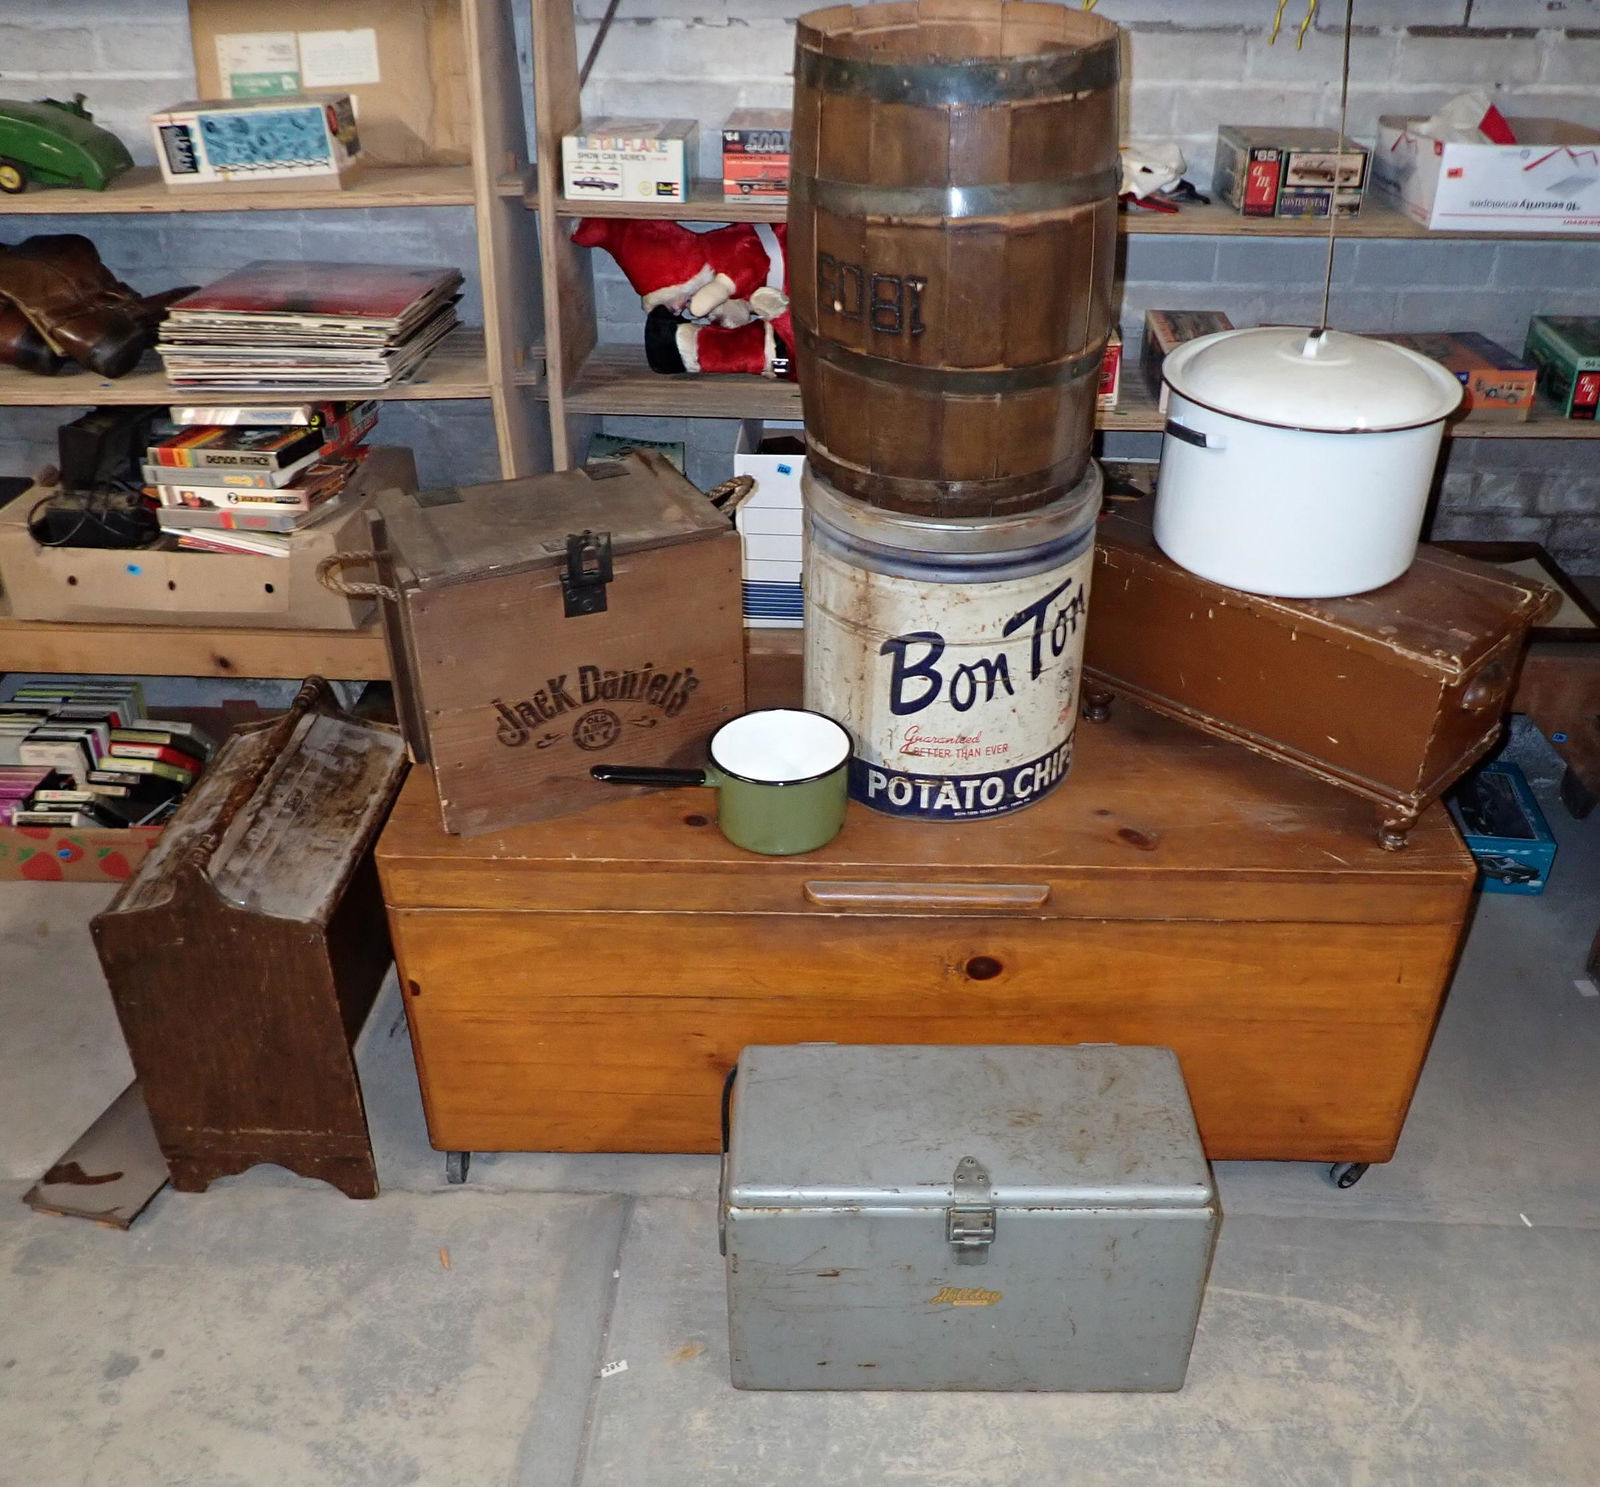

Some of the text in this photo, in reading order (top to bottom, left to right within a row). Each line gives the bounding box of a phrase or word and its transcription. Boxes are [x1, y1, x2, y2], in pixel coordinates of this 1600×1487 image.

[206, 455, 237, 465] DEMON
[879, 577, 1085, 716] Bon Ton
[578, 662, 699, 718] Daniel's
[901, 725, 983, 752] Guaranteed
[912, 743, 1009, 758] BETTER THAN EVER
[868, 769, 1006, 809] POTATO
